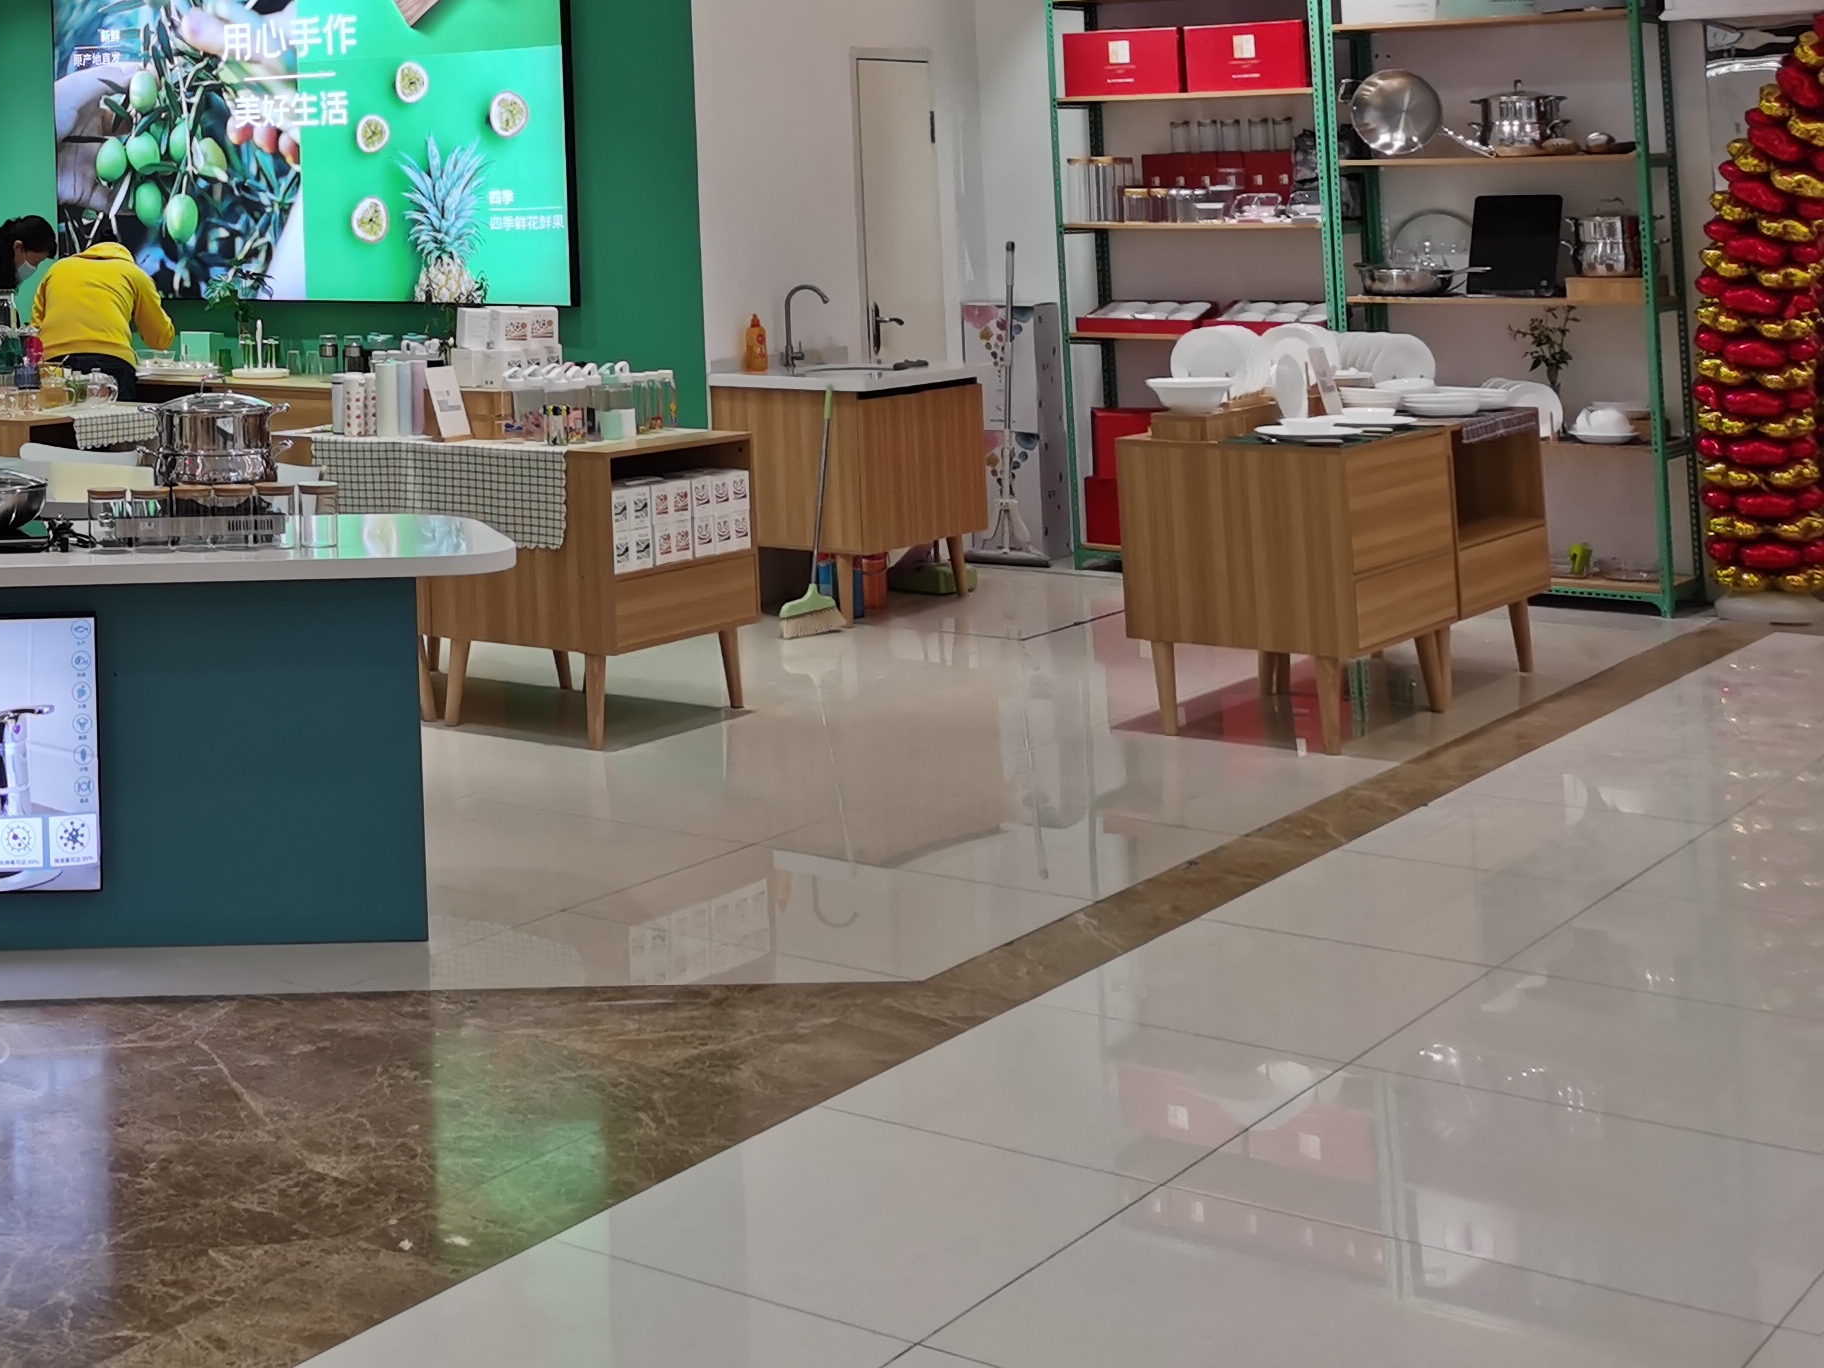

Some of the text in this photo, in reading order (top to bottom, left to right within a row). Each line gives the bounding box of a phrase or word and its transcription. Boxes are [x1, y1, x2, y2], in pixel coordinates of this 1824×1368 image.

[222, 14, 357, 62] 用心手作
[234, 91, 349, 129] 美好生活
[488, 189, 514, 205] 四季
[490, 214, 565, 232] 四季鲜花鲜果
